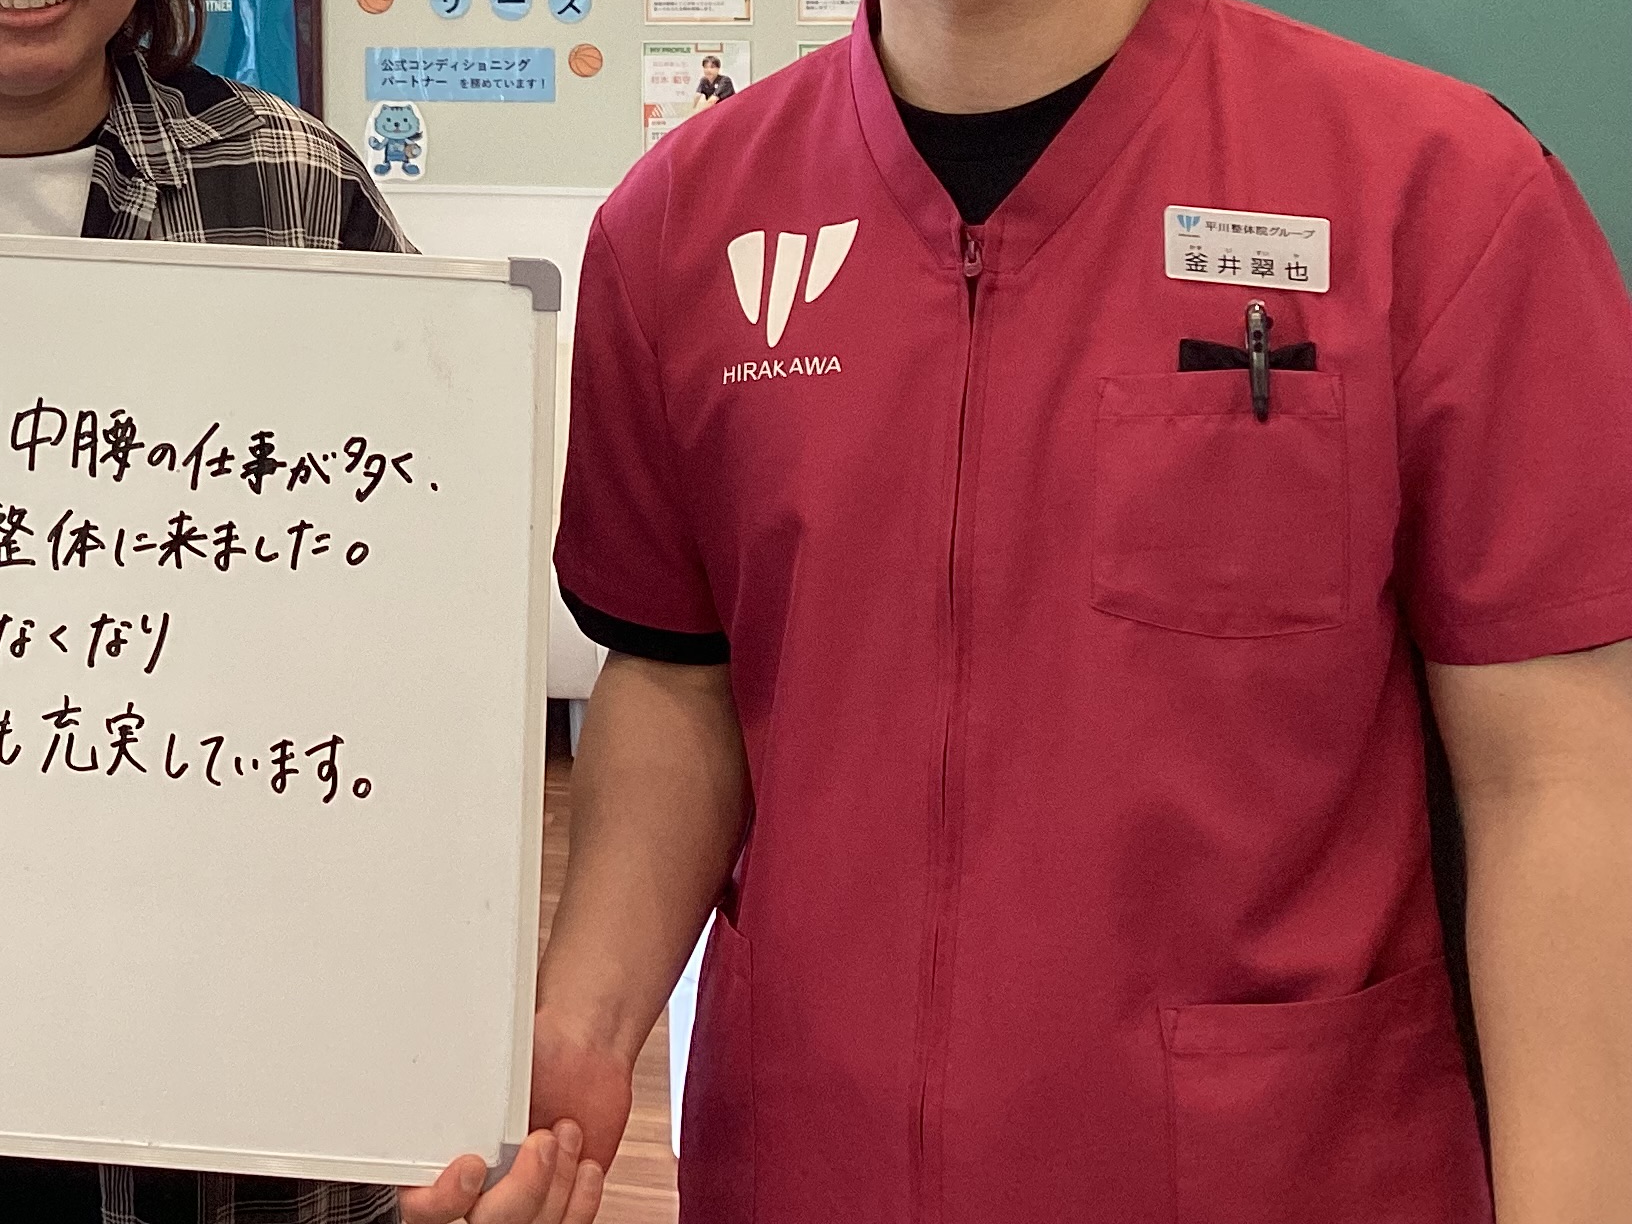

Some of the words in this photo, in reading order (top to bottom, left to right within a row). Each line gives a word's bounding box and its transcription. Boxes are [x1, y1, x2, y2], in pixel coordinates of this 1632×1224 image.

[380, 57, 531, 73] 公式コンディショニング
[380, 75, 449, 88] パートナー
[1204, 220, 1316, 240] 平川整体院グループ
[1184, 251, 1310, 283] 釜井翠也
[722, 355, 842, 385] HIRAKAWA
